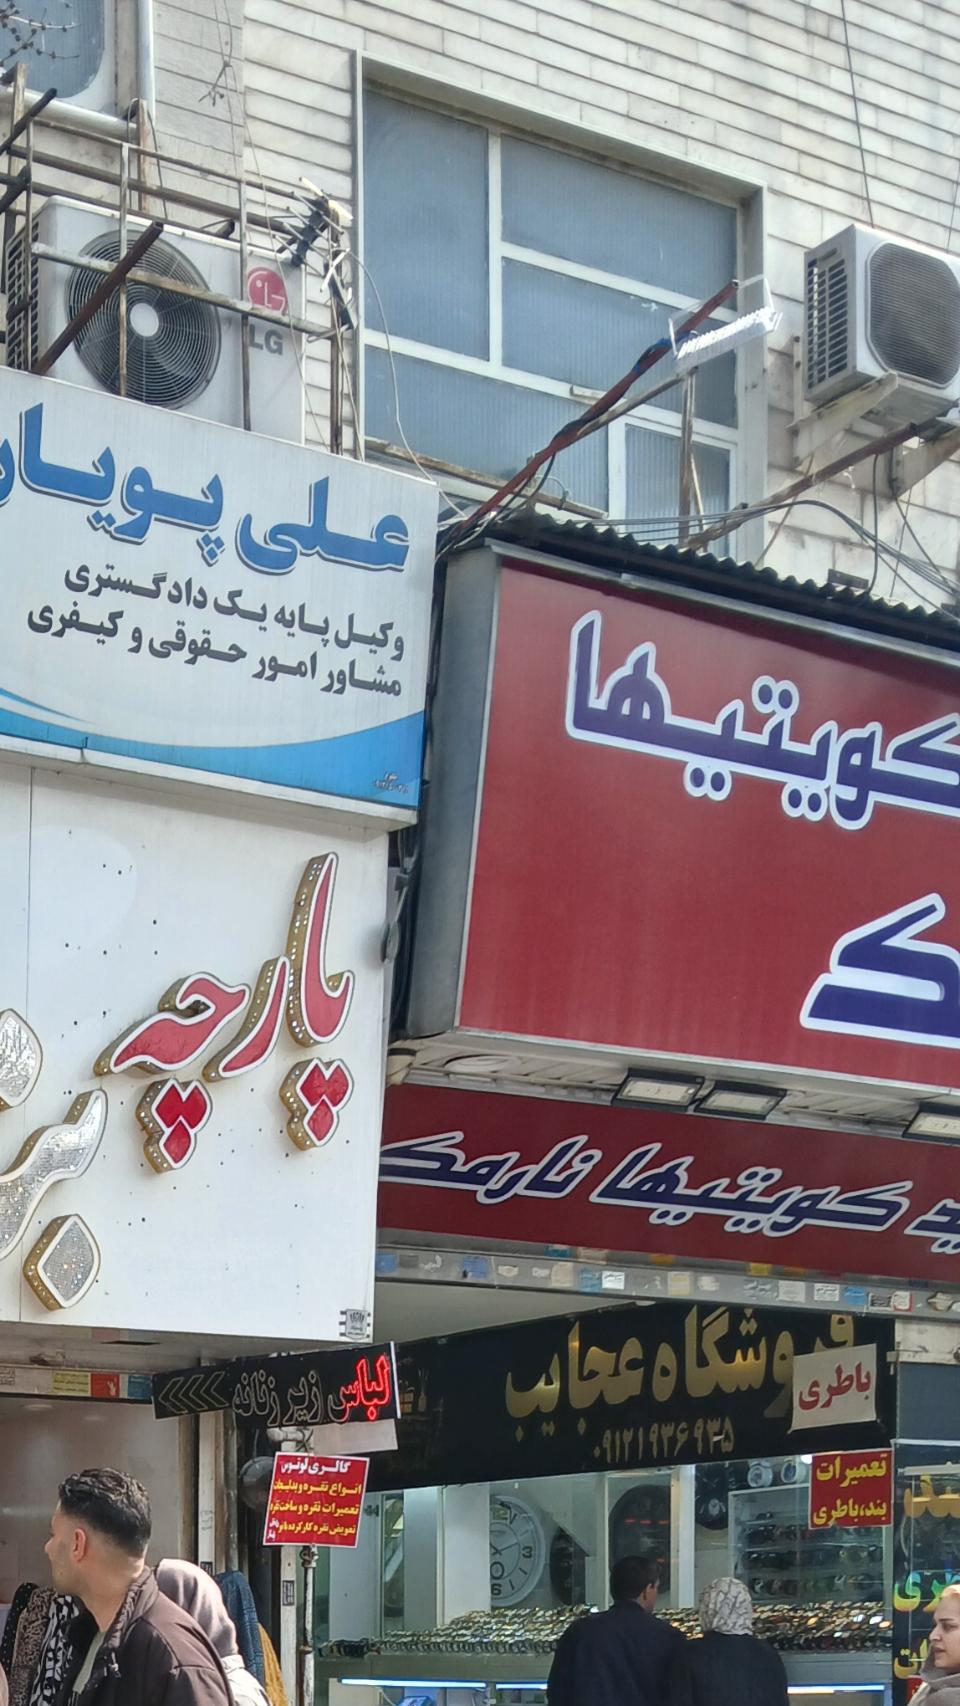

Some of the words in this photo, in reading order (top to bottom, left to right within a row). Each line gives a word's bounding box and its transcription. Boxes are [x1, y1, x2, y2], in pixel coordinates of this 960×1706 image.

[249, 323, 283, 356] LG
[235, 474, 410, 576] علی
[64, 563, 208, 611] دادگستری
[27, 600, 125, 646] کیفری
[214, 588, 268, 633] یک
[273, 602, 330, 648] پایه
[126, 625, 143, 654] و
[148, 620, 248, 665] حقوقی
[334, 613, 404, 662] وکیل
[251, 650, 318, 683] امور
[320, 658, 403, 697] مشاور
[564, 610, 960, 830] کویتیها
[93, 851, 356, 1174] پارچه
[380, 1130, 603, 1205] نارمک
[589, 1142, 914, 1238] کویتیها
[505, 1319, 644, 1443] عجایب
[652, 1304, 855, 1418] فوشگاه
[233, 1369, 281, 1427] زنانه
[282, 1369, 323, 1427] زیر
[328, 1354, 390, 1422] لباس
[798, 1361, 872, 1411] باطری
[303, 1481, 329, 1494] نقره
[329, 1482, 362, 1496] انواع
[815, 1453, 888, 1487] تعمیرات
[322, 1502, 359, 1516] تعمیرات
[522, 1546, 533, 1559] 3
[490, 1583, 502, 1596] 6
